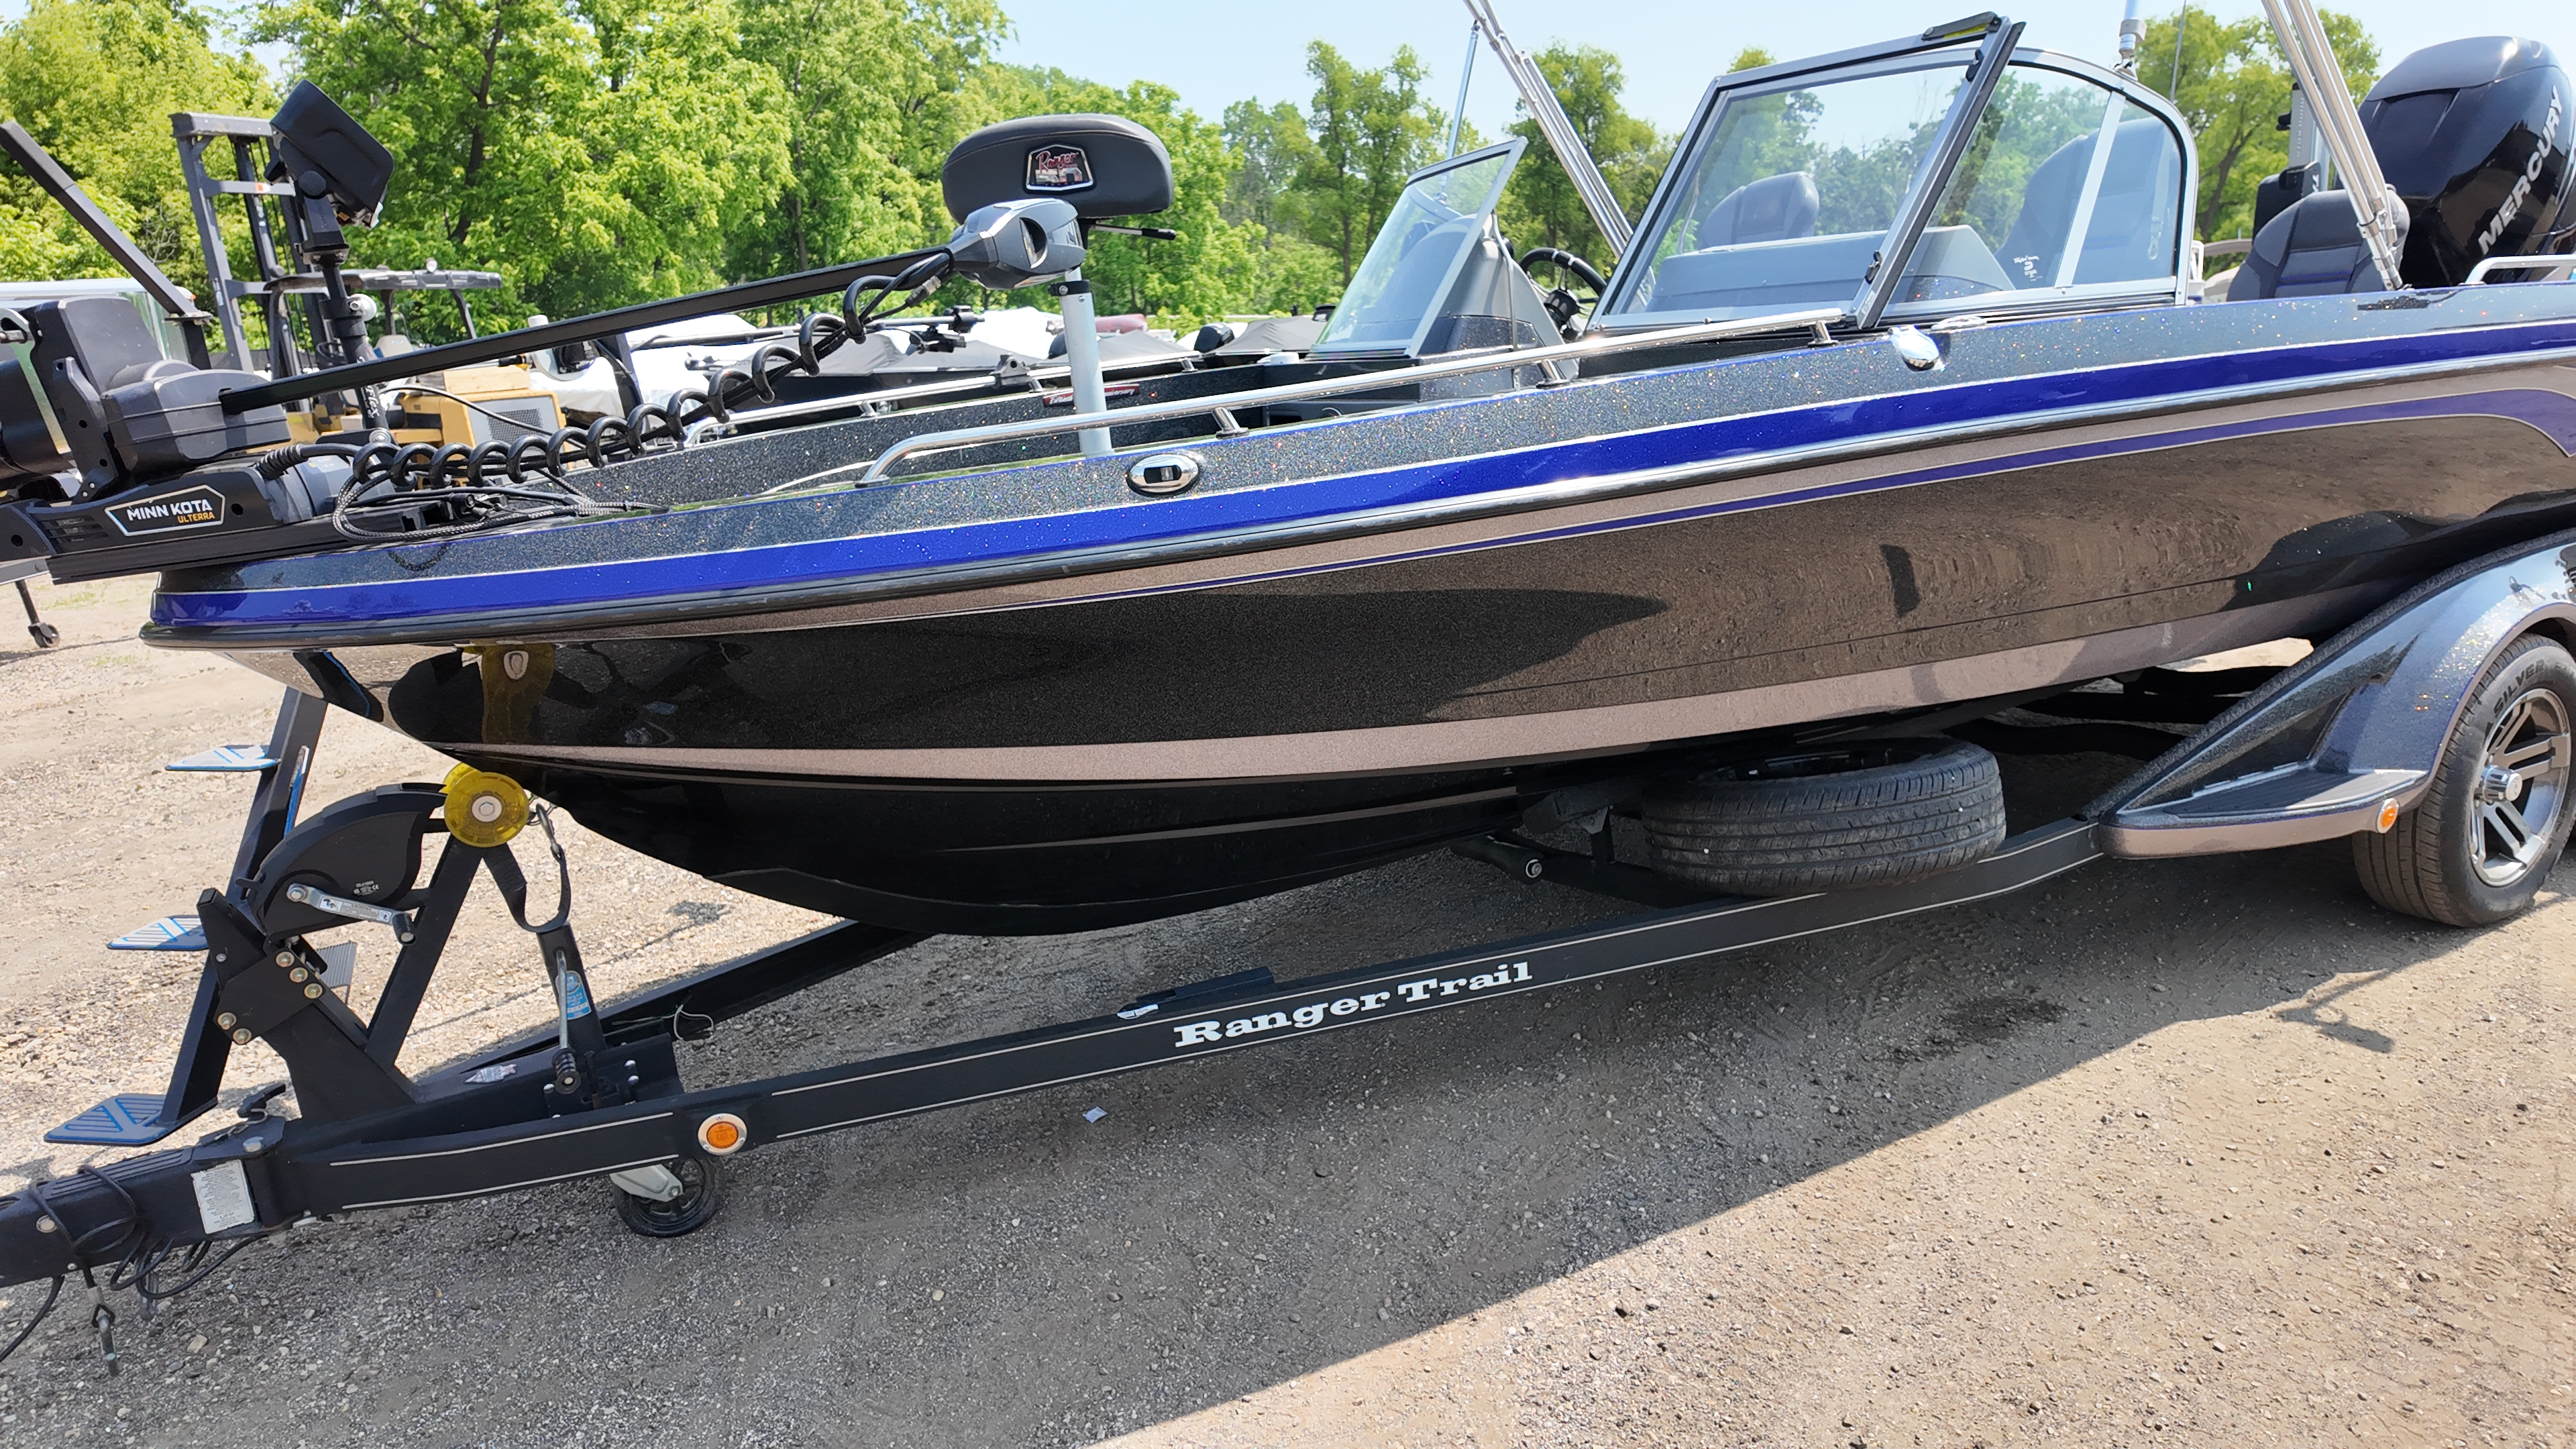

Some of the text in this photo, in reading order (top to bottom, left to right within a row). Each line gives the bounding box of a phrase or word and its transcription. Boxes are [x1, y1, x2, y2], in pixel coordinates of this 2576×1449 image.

[1035, 150, 1077, 174] Ranger
[2478, 85, 2563, 256] MERCURY
[126, 499, 213, 521] MINN KOTA
[177, 513, 215, 523] ULTERRA
[1173, 961, 1534, 1048] Ranger Trail
